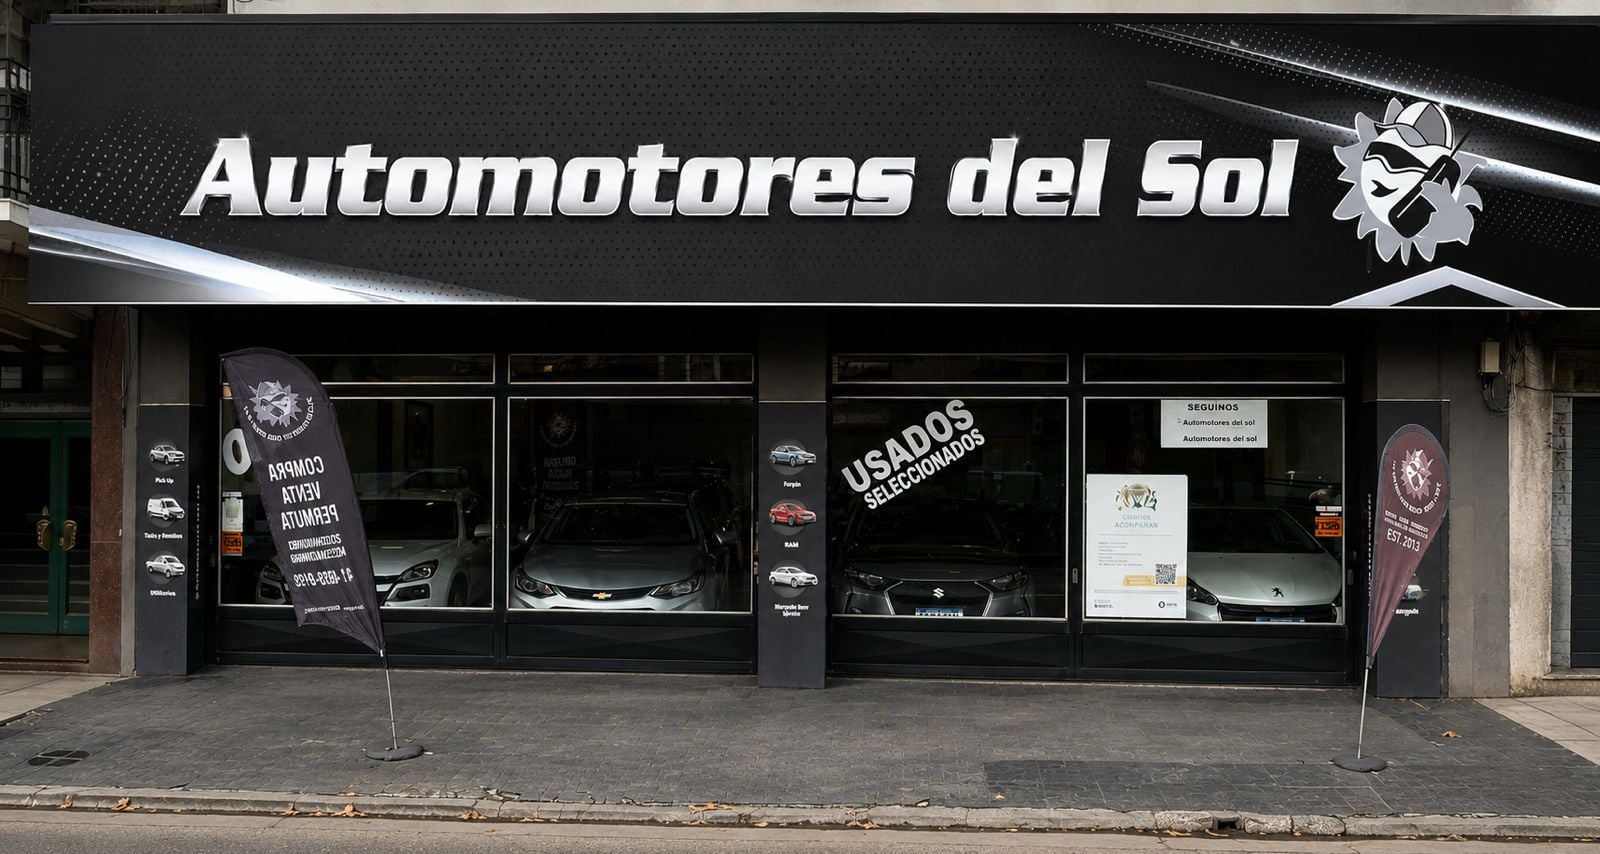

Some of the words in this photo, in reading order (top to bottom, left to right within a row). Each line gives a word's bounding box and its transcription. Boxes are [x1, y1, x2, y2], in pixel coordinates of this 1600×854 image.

[179, 137, 916, 216] Automotores
[946, 137, 1110, 216] del
[1137, 138, 1299, 216] Sol
[841, 399, 974, 493] USADOS
[864, 428, 986, 510] SELECCIONADOS
